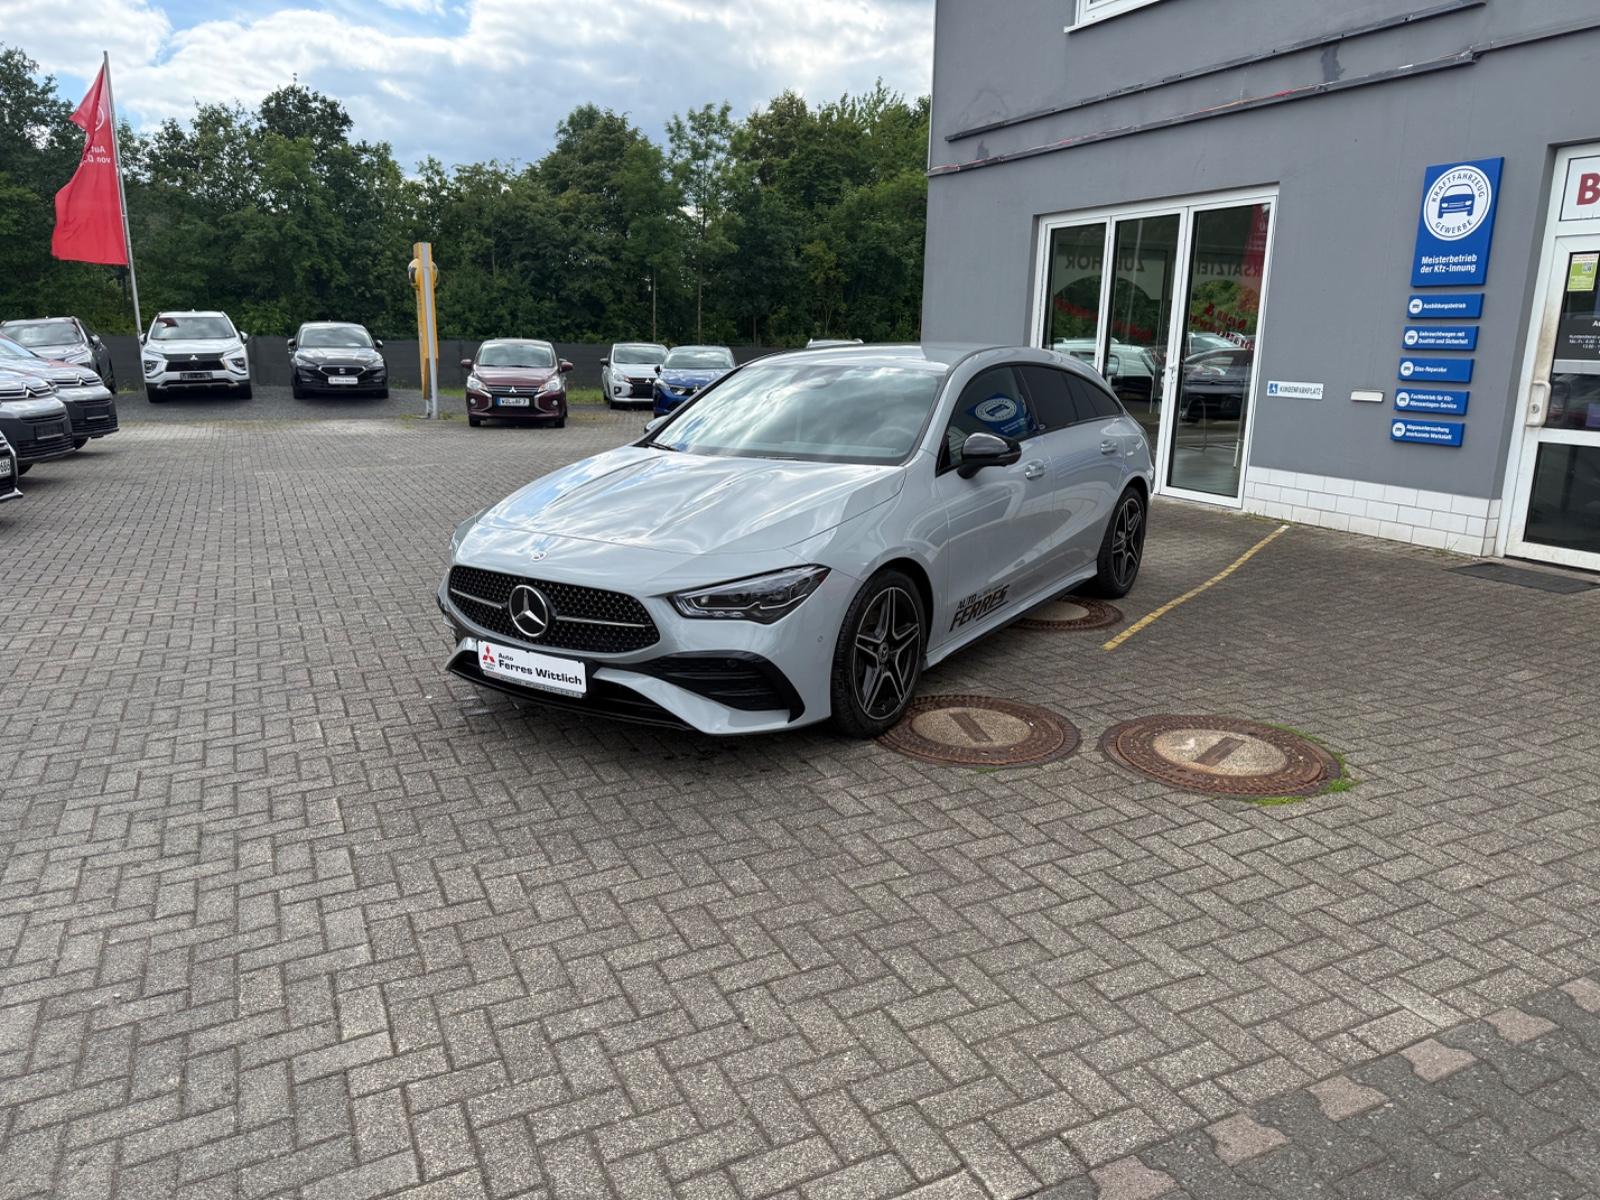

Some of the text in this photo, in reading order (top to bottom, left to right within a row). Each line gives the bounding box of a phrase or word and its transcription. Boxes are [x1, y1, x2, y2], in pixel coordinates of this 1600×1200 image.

[1432, 172, 1486, 202] KRAFTFAHRZEUG
[1435, 219, 1473, 235] GEWERBE
[1421, 254, 1478, 265] Meisterbetrieb
[1420, 264, 1476, 274] der Kfz-Innung
[957, 593, 977, 610] AUTO
[498, 653, 514, 662] Auto
[498, 660, 533, 675] Ferres
[535, 667, 582, 686] Wittlich
